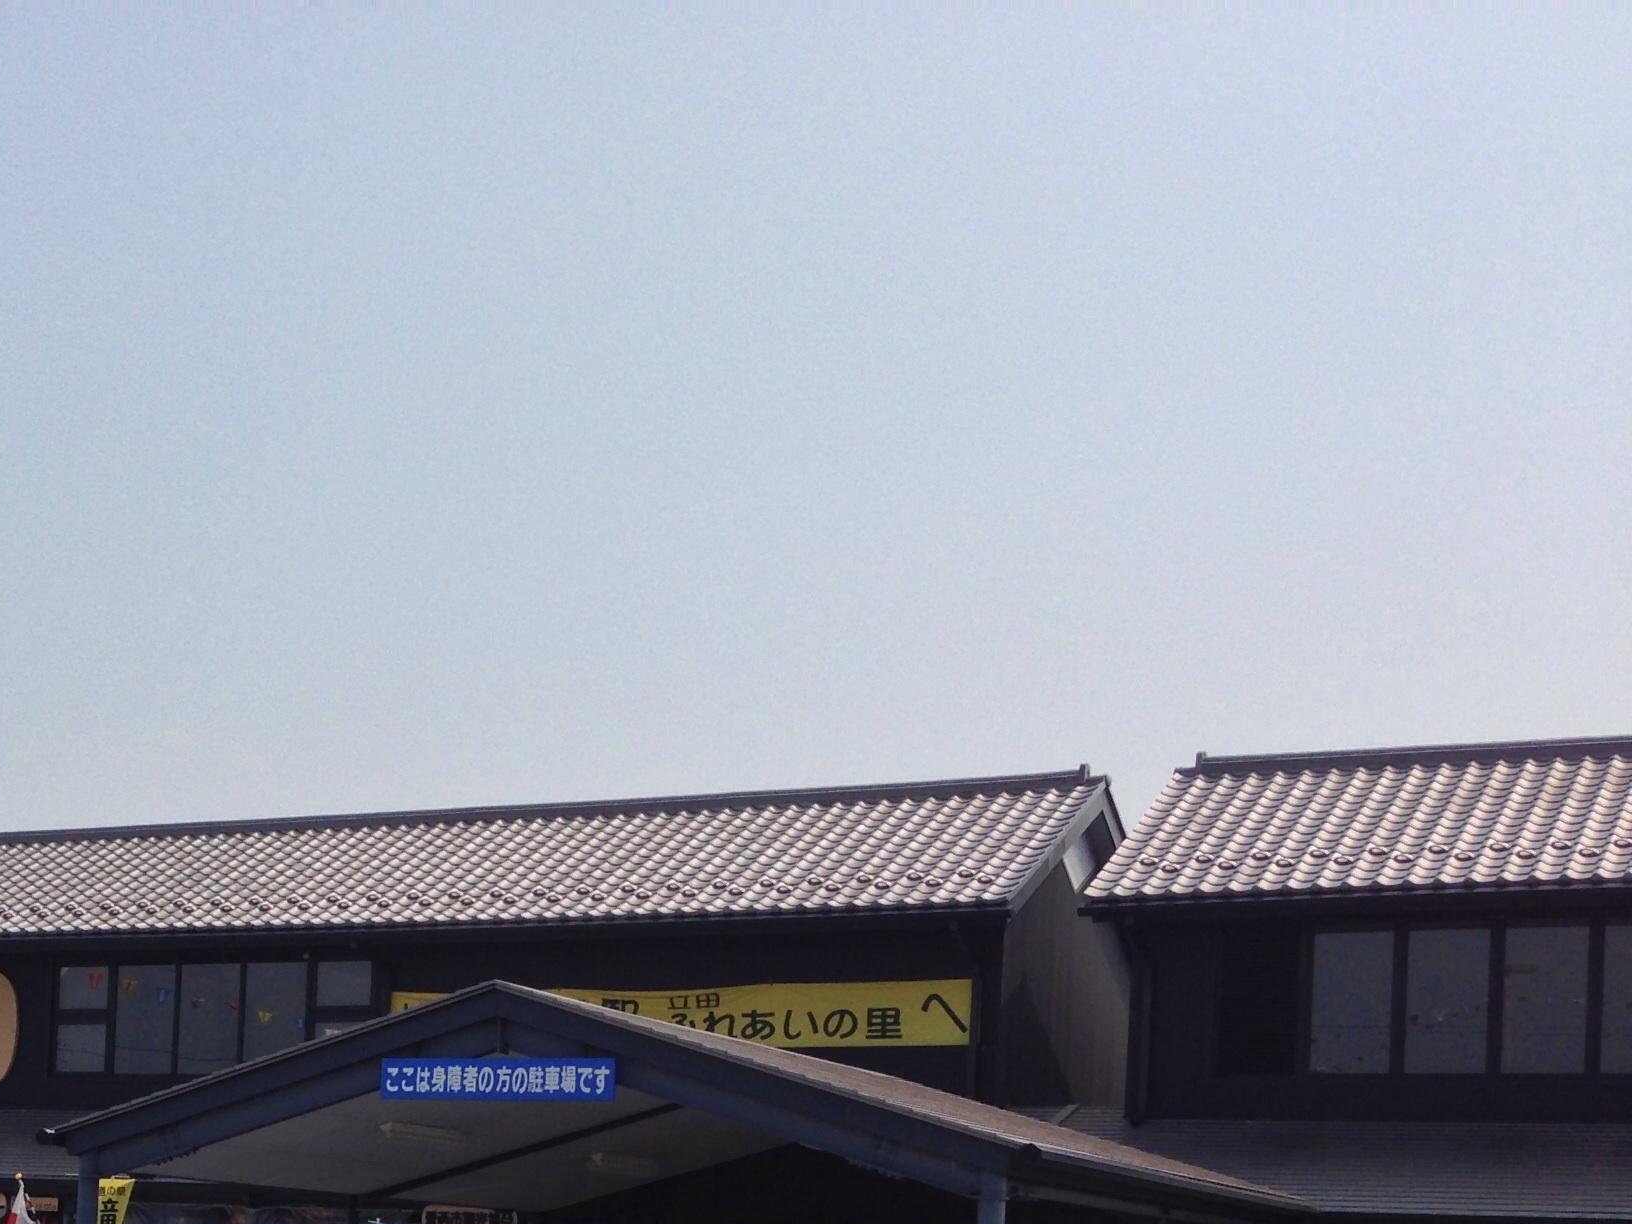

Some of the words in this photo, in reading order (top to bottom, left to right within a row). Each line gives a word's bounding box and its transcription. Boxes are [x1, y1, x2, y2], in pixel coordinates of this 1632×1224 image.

[386, 1065, 611, 1094] ここは身障者の方の駐車場です
